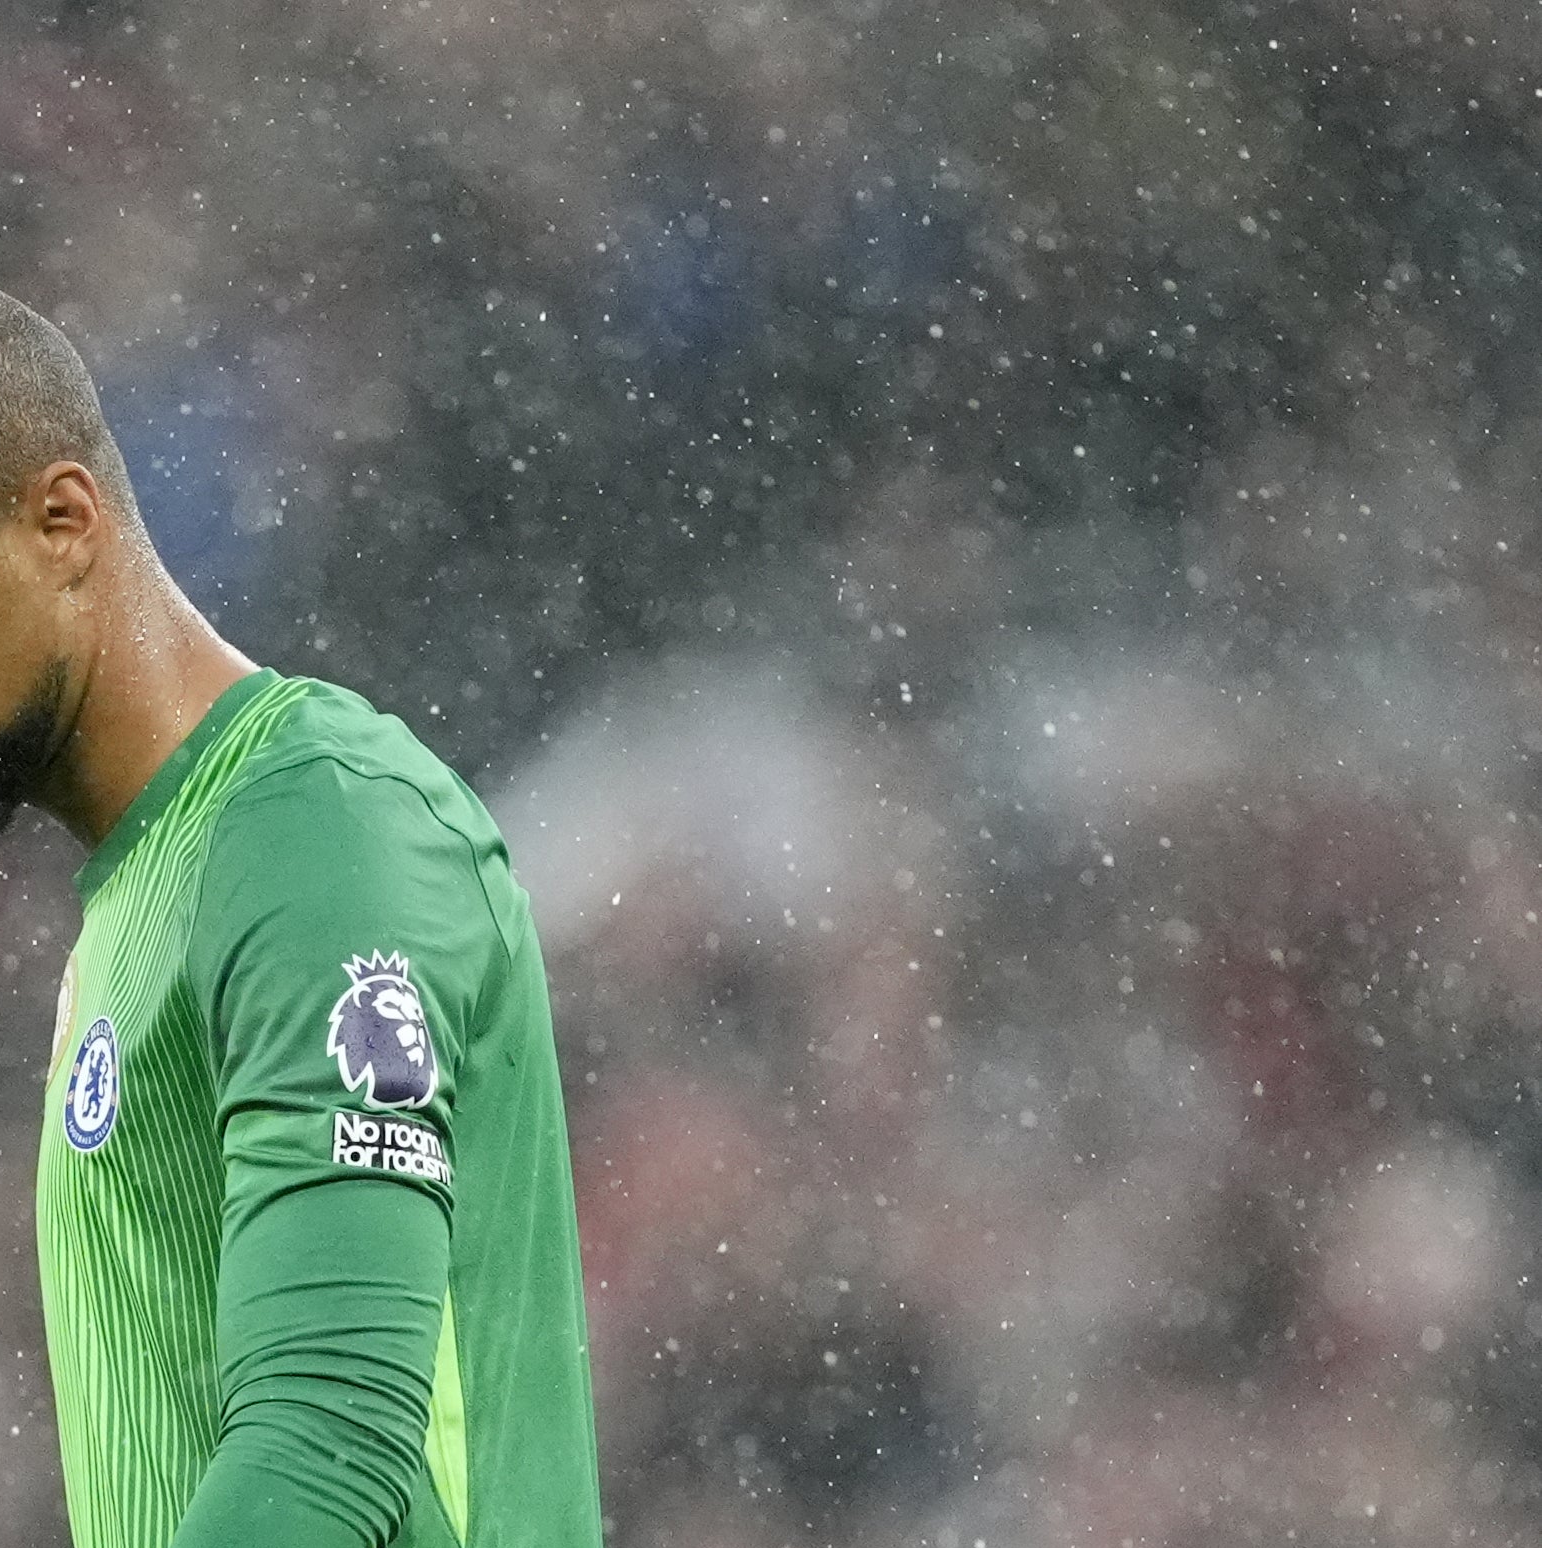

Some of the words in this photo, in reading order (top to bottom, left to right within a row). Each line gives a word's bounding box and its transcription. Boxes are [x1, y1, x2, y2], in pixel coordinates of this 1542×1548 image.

[334, 1112, 380, 1143] No
[384, 1122, 442, 1159] room
[333, 1138, 379, 1168] for
[382, 1147, 451, 1187] racism
